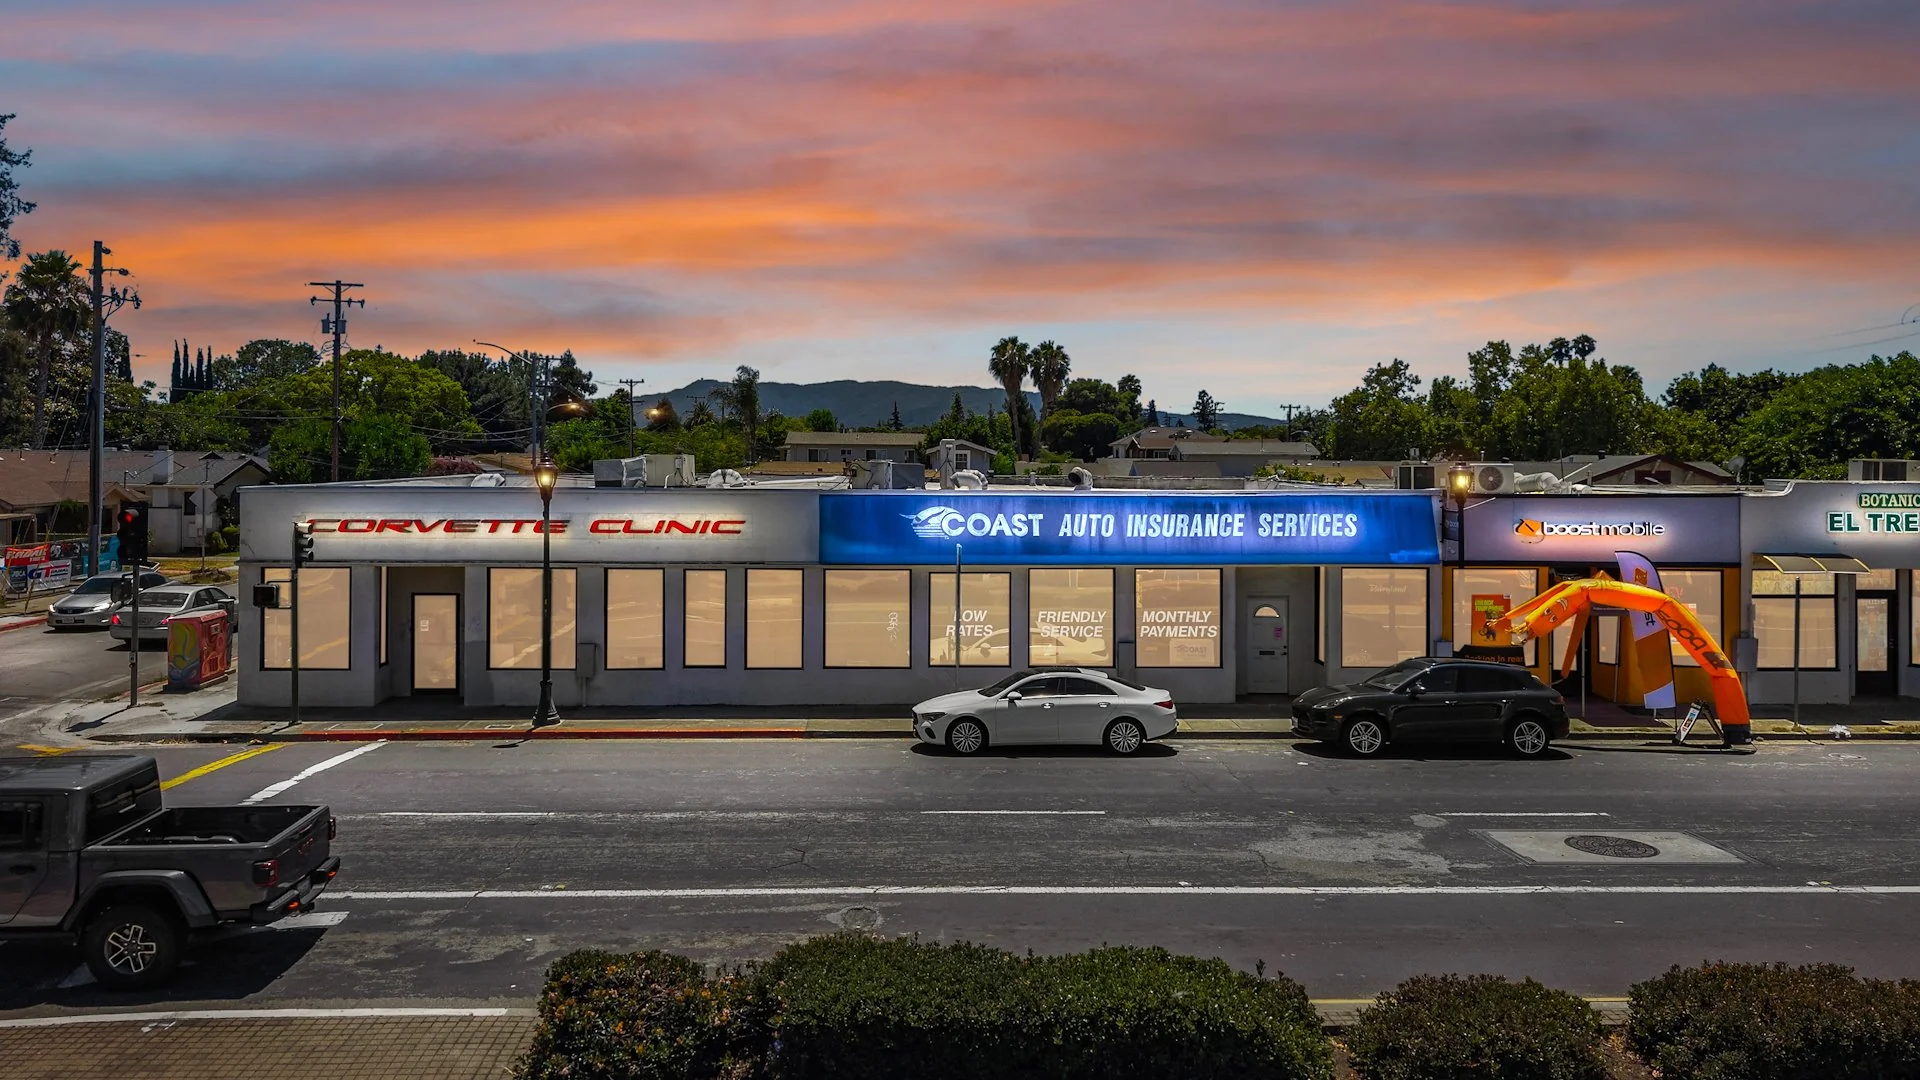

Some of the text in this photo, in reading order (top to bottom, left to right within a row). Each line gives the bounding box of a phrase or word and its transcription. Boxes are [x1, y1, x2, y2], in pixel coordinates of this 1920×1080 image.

[1861, 495, 1920, 507] BOTANIC
[306, 519, 746, 534] CORVETTE CLINIC
[942, 512, 1358, 538] COAST AUTO INSURANCE SERVICES
[1828, 512, 1920, 533] EL TRE
[953, 610, 987, 622] LOW
[1038, 611, 1107, 623] FRIENDLY
[1142, 611, 1212, 623] MONTHLY
[946, 625, 993, 637] RATES
[1041, 626, 1104, 638] SERVICE
[1140, 626, 1217, 638] PAYMENTS
